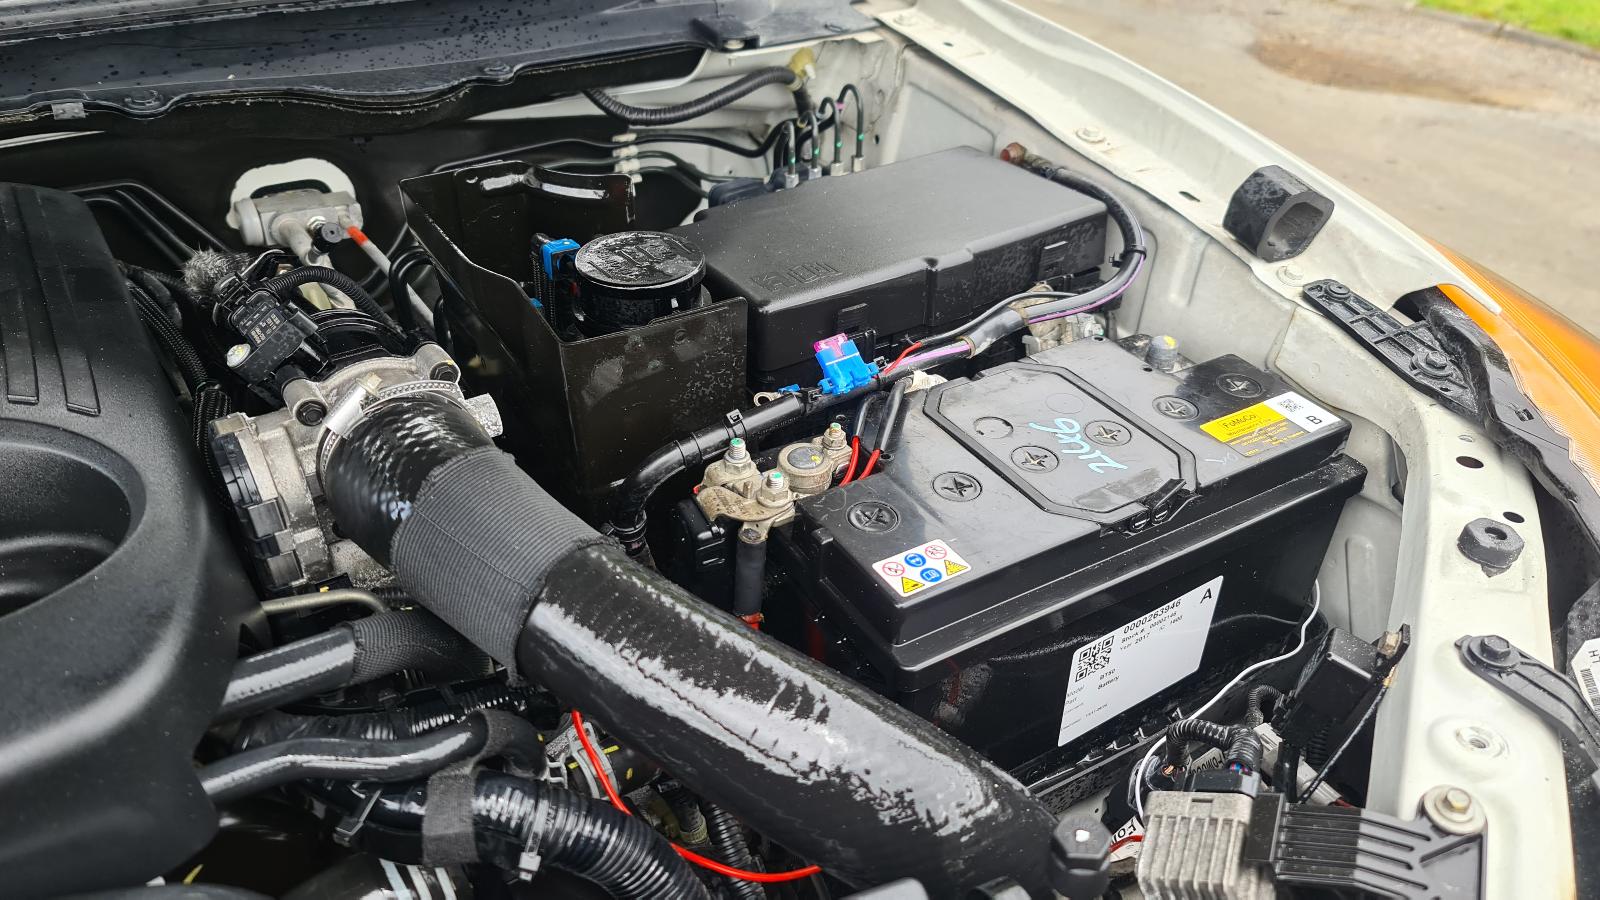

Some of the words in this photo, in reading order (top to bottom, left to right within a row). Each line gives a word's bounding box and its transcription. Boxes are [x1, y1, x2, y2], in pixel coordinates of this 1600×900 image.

[1305, 415, 1322, 425] B
[1199, 587, 1213, 604] A
[1123, 598, 1181, 634] 0000263946
